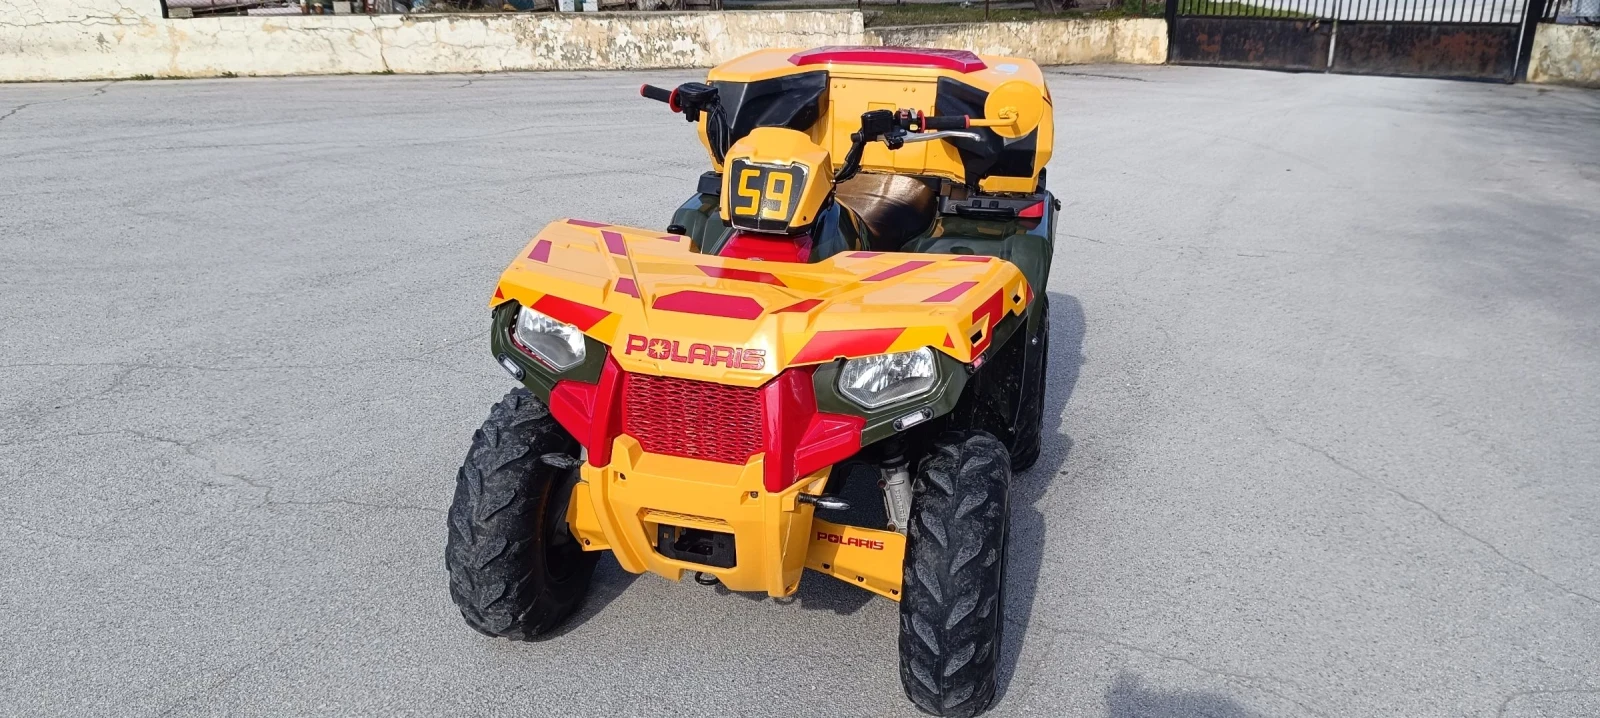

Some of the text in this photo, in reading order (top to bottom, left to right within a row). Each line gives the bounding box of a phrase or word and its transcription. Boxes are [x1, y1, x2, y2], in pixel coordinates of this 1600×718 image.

[735, 169, 792, 220] 59
[625, 334, 766, 370] POLARIS
[895, 488, 907, 522] POLARIS
[817, 532, 884, 550] POLARIS
